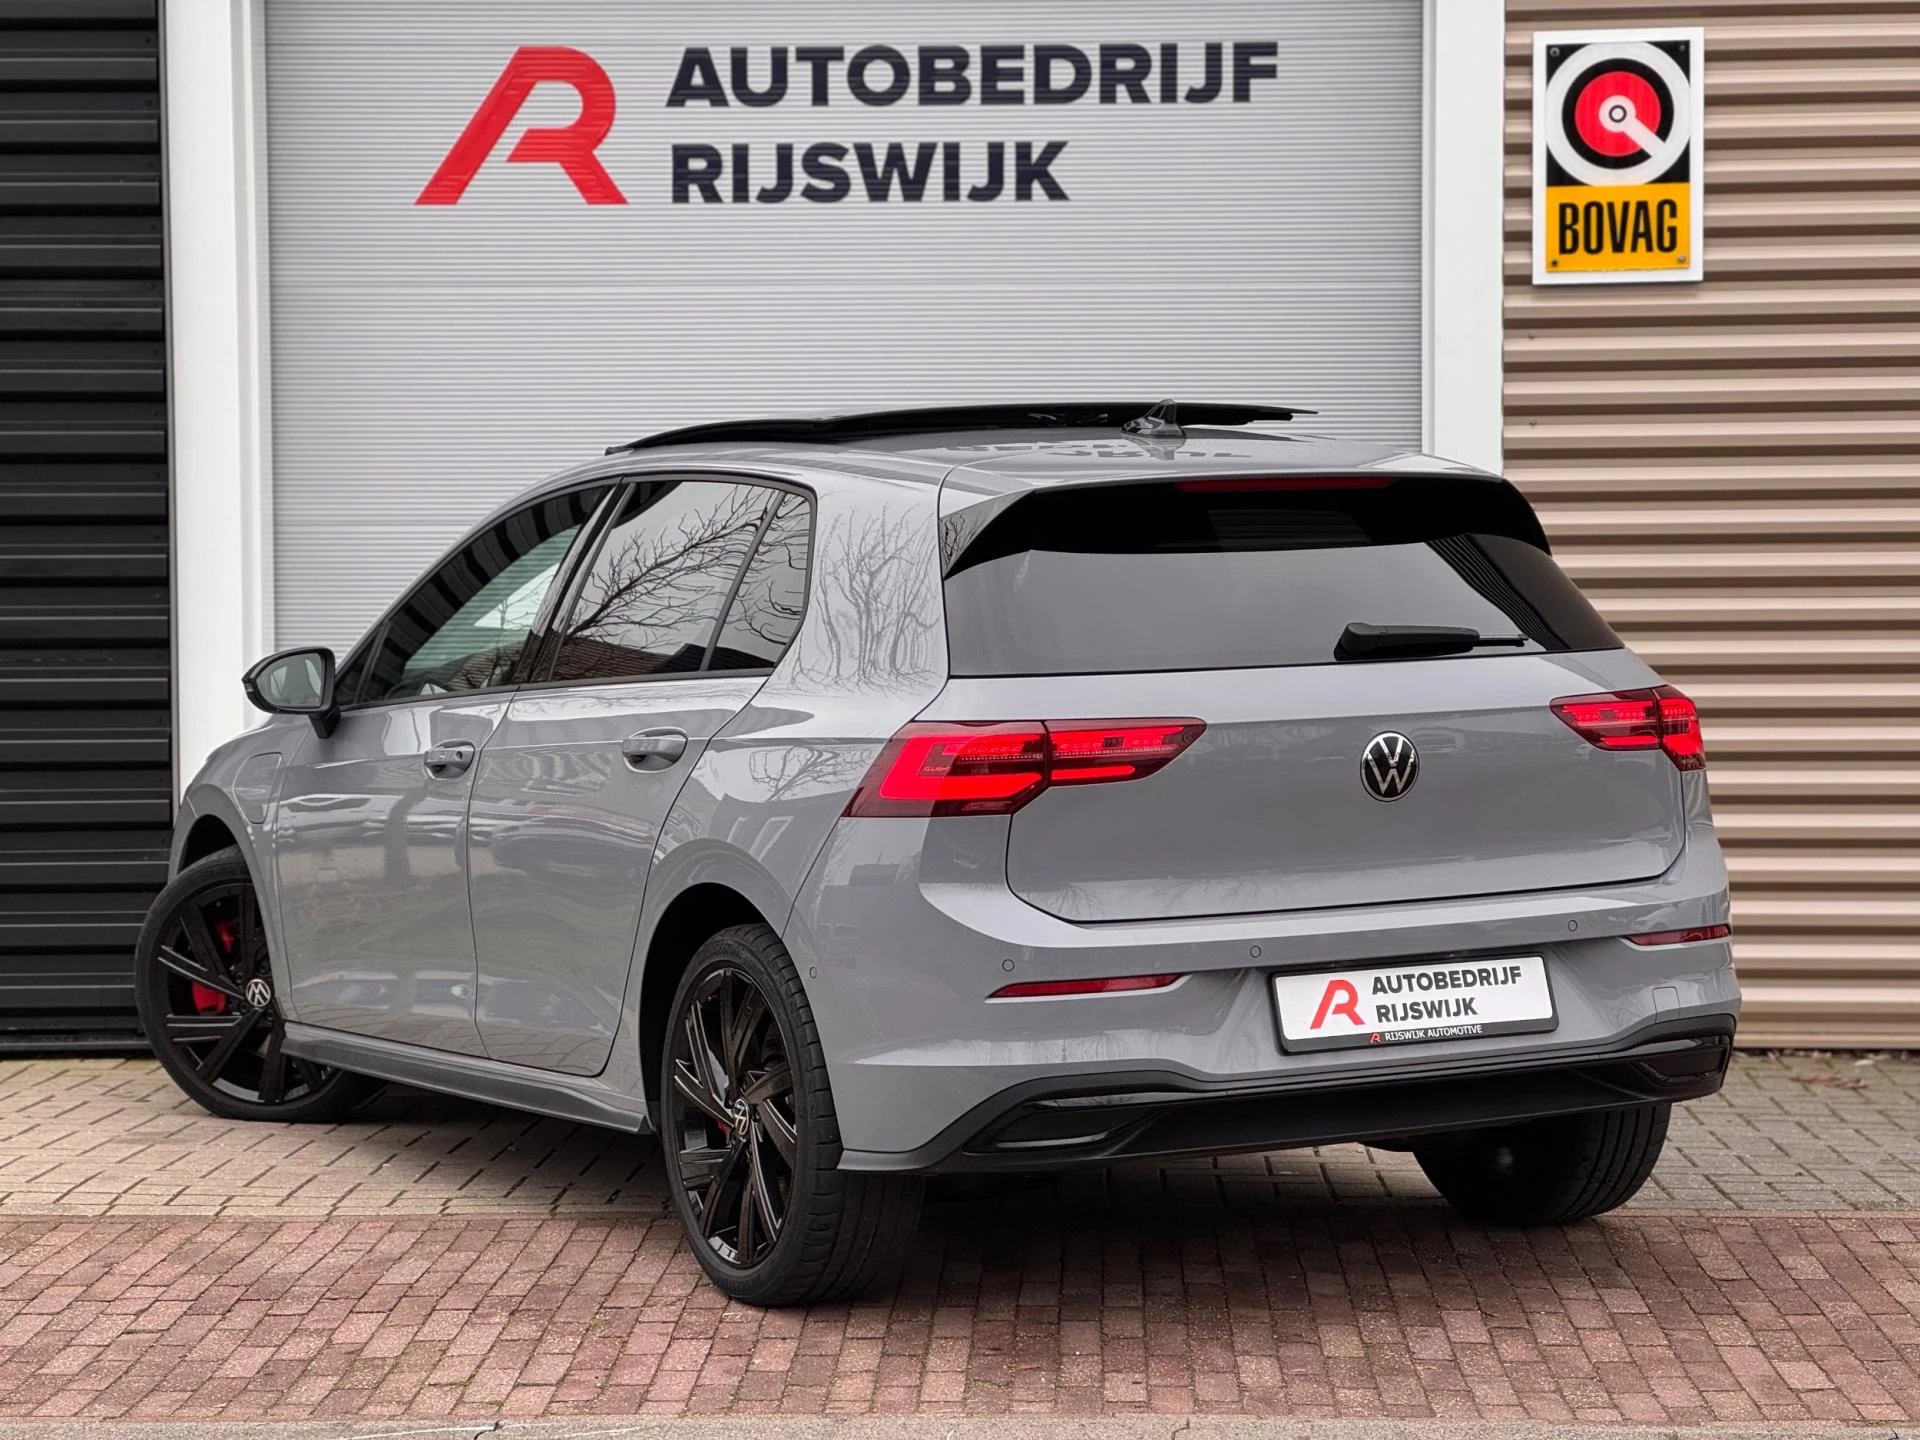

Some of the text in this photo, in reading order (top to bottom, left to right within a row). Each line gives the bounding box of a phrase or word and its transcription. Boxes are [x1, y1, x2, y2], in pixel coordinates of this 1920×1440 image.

[665, 42, 1279, 108] AUTOBEDRIJF
[671, 141, 1070, 204] RIJSWIJK
[1558, 199, 1678, 256] BOVAG
[1371, 965, 1522, 996] AUTOBEDRIJF
[1375, 997, 1479, 1024] RIJSWIJK
[1384, 1029, 1426, 1042] RIJSWIJK
[1427, 1024, 1483, 1038] AUTOMOTIVE
